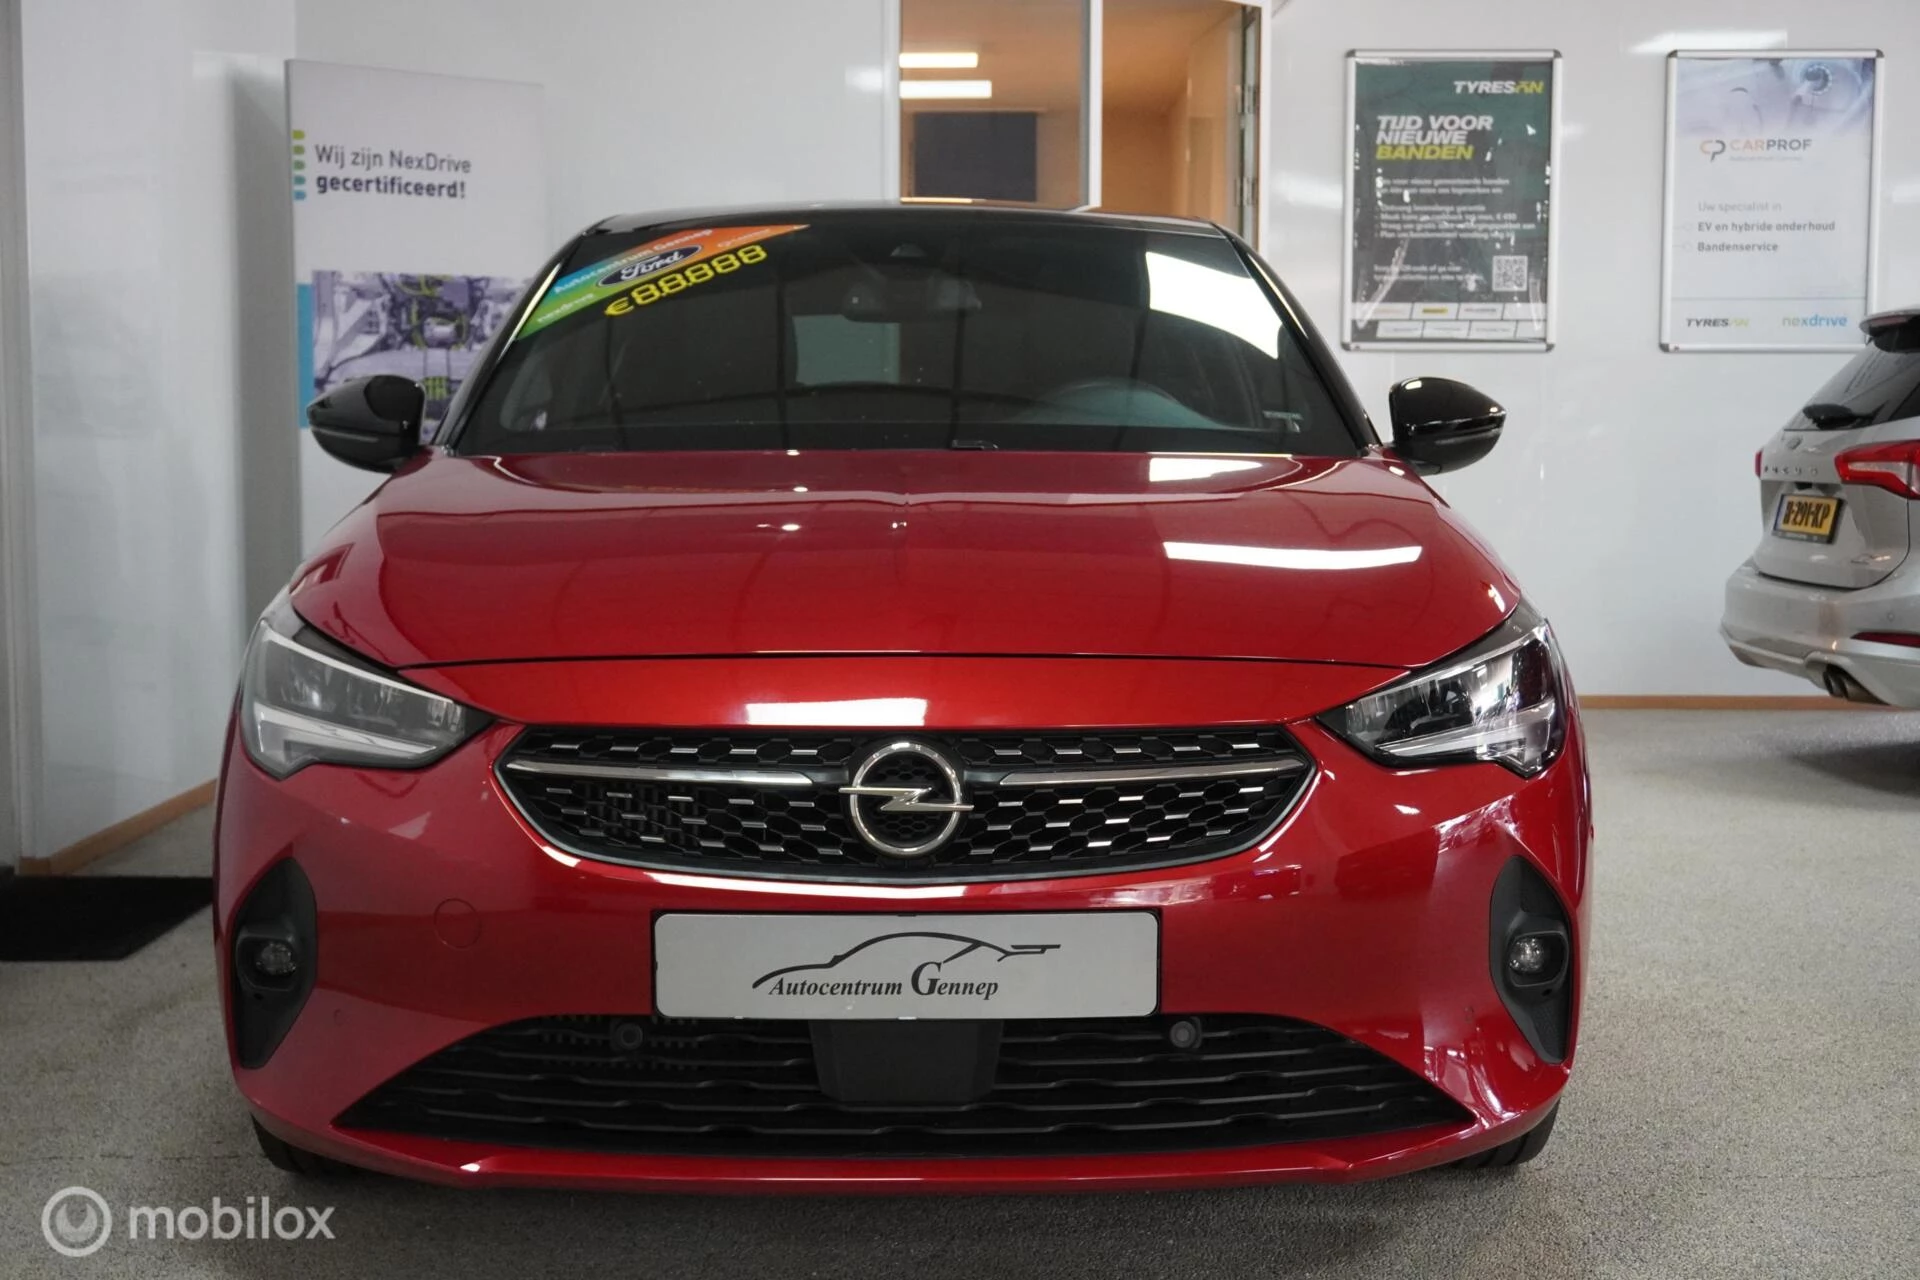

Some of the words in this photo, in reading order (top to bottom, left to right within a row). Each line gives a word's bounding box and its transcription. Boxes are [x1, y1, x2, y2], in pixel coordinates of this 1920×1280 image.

[1429, 115, 1494, 131] VOOR
[1375, 130, 1468, 145] NIEUWE
[1729, 138, 1813, 151] CARPROF
[314, 144, 346, 169] Wij
[351, 149, 383, 171] zijn
[389, 150, 471, 173] NexDrive
[1375, 145, 1474, 160] BANDEN
[316, 174, 466, 199] gecertificeerd!
[1698, 202, 1715, 212] Uw
[1718, 201, 1769, 213] specialist
[1772, 202, 1782, 212] in
[1697, 222, 1713, 232] EV
[1715, 223, 1728, 232] en
[1731, 221, 1773, 233] hybride
[1775, 221, 1836, 232] onderhoud
[1697, 241, 1779, 252] Bandenservice
[619, 250, 686, 281] Ford
[768, 976, 903, 997] Autocentrum
[910, 961, 999, 1000] Gennep
